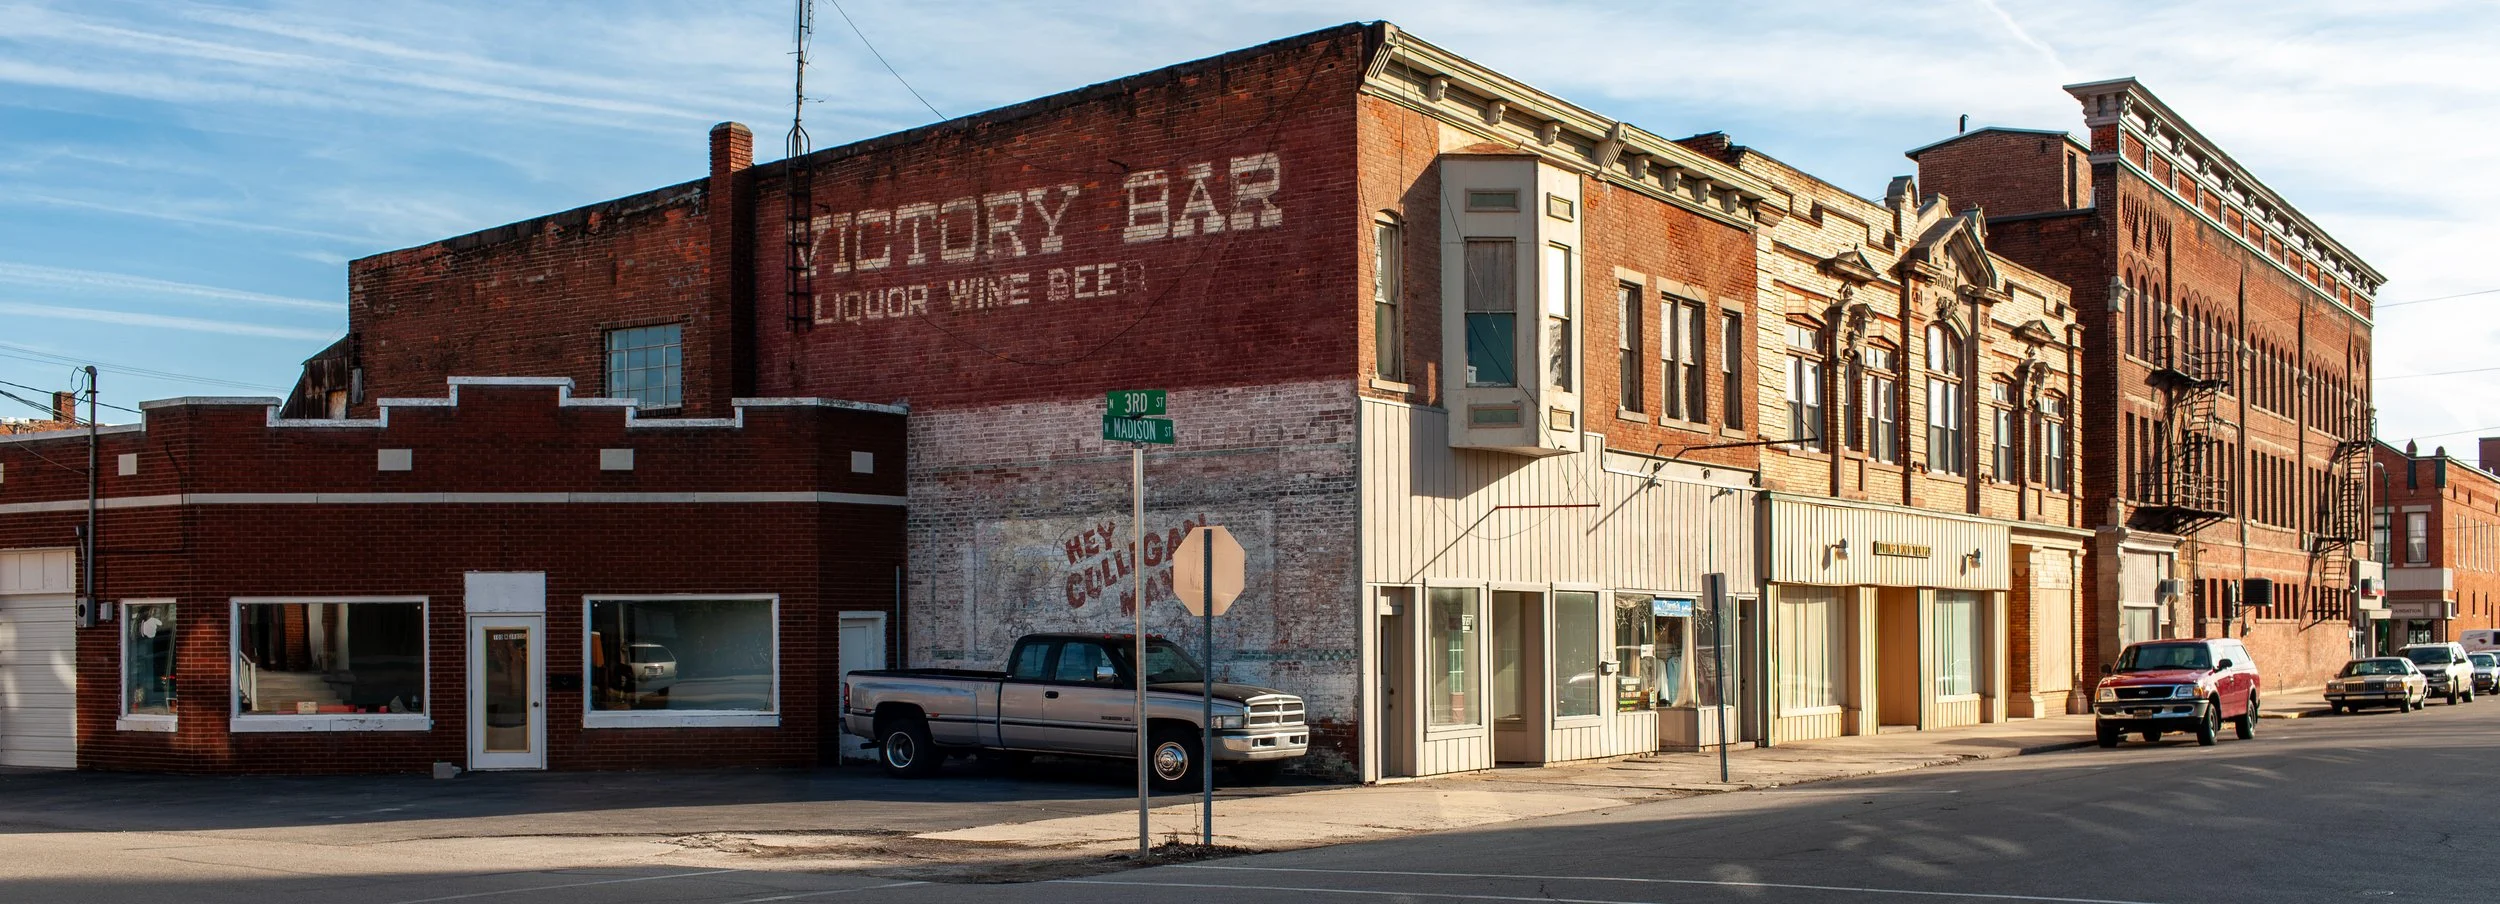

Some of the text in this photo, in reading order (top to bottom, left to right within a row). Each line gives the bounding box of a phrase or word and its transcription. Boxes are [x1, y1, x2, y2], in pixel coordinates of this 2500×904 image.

[788, 152, 1283, 278] VICTORY BAR
[814, 260, 1147, 326] LIQUOR WINE BEER
[1109, 393, 1164, 413] N 3RD ST
[1104, 418, 1171, 440] W MADISON ST
[1066, 522, 1115, 565] HEY
